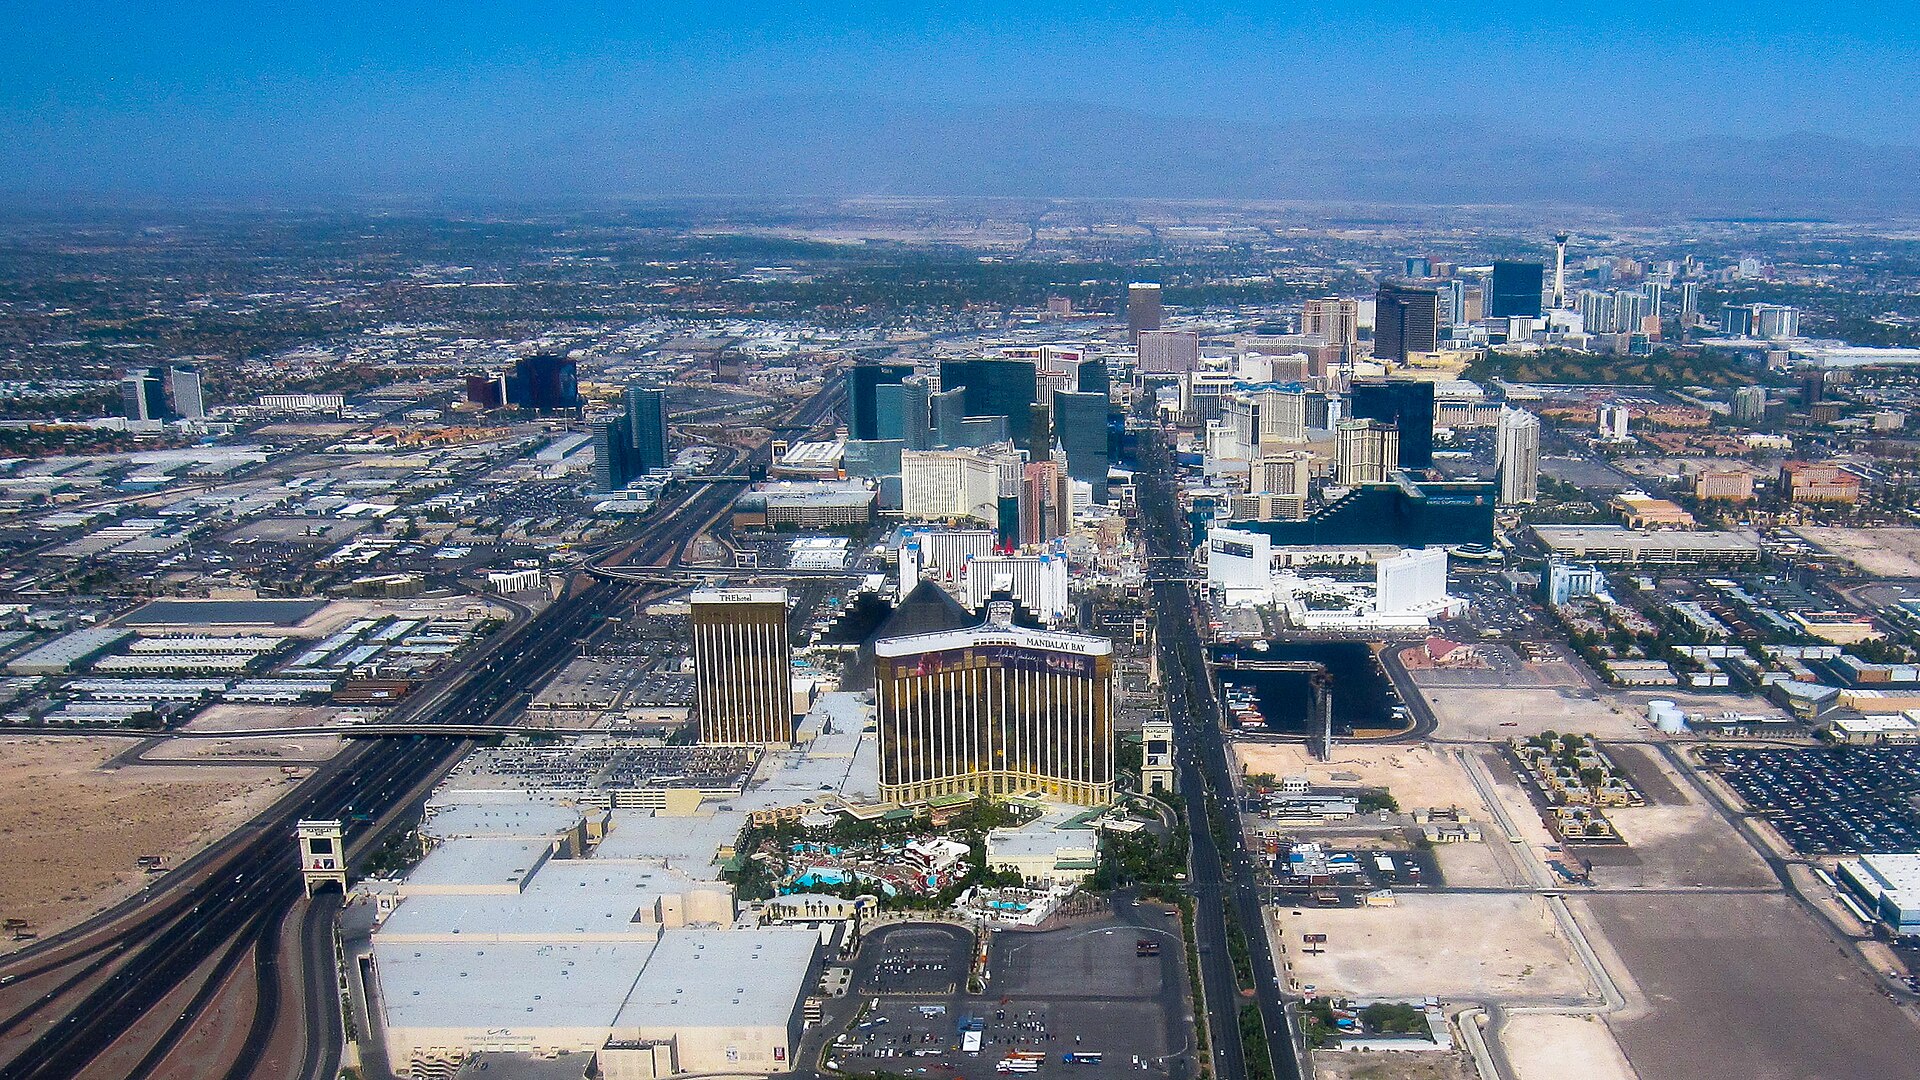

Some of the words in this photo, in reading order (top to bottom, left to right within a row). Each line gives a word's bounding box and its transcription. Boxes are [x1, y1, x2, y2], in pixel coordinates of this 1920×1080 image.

[719, 594, 752, 602] THEhotel
[1026, 638, 1069, 650] MANDALAY
[1071, 641, 1086, 652] BAY
